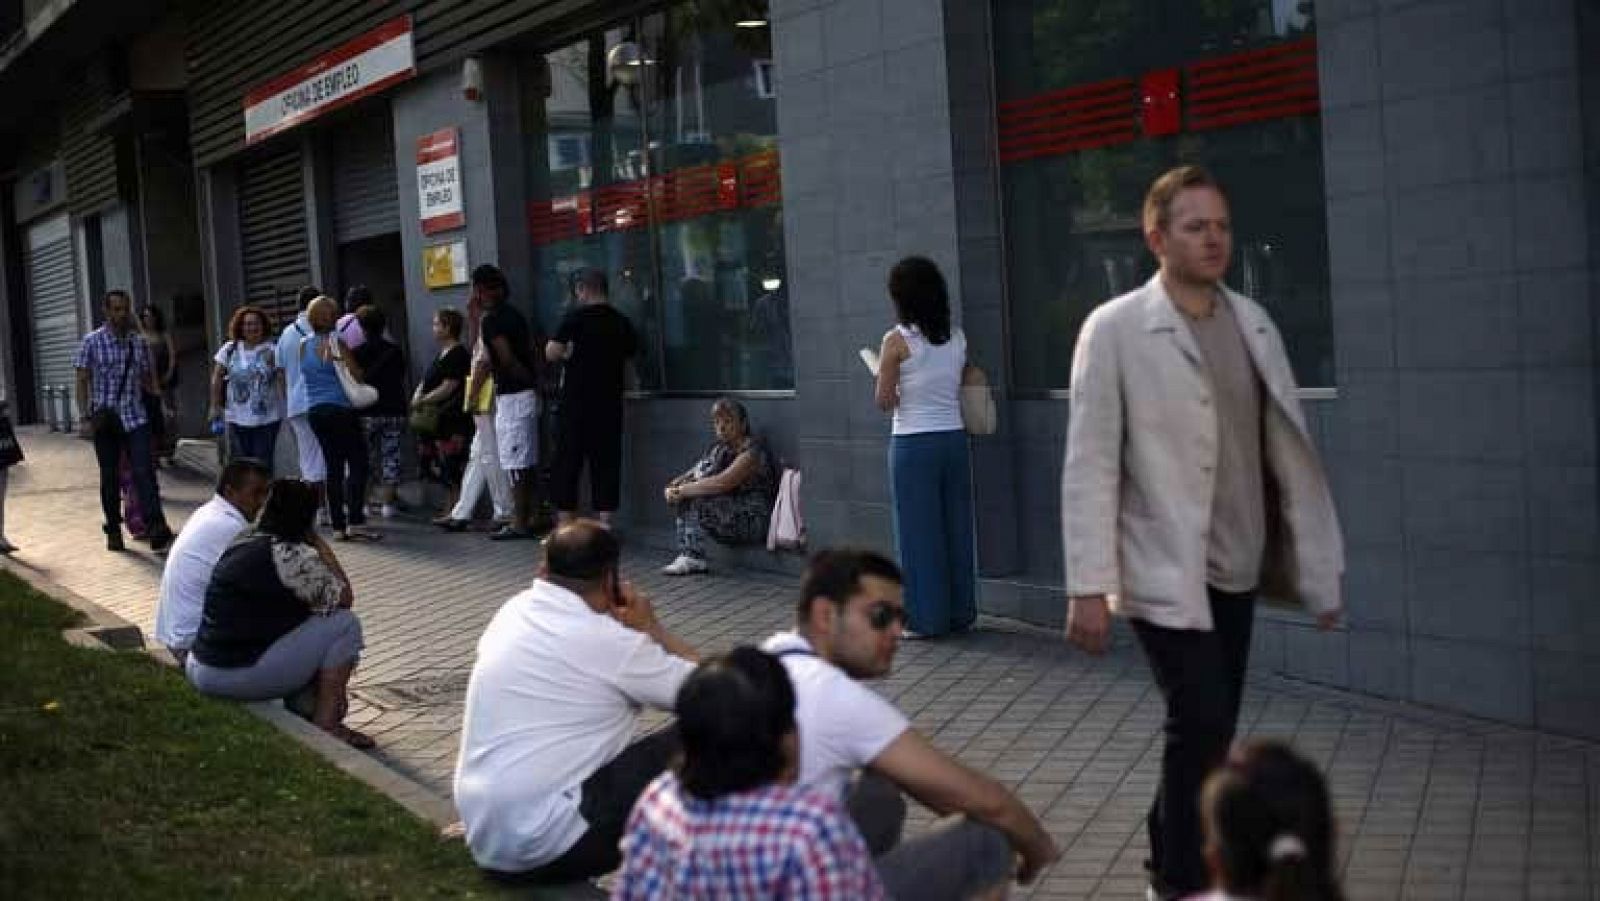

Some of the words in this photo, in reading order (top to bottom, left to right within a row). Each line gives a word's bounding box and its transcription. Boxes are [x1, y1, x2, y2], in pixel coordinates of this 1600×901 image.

[312, 79, 324, 104] DE
[324, 63, 359, 97] EMPLEO
[421, 169, 444, 190] OFICINA
[446, 166, 455, 184] DE
[427, 188, 452, 207] EMPLEO
